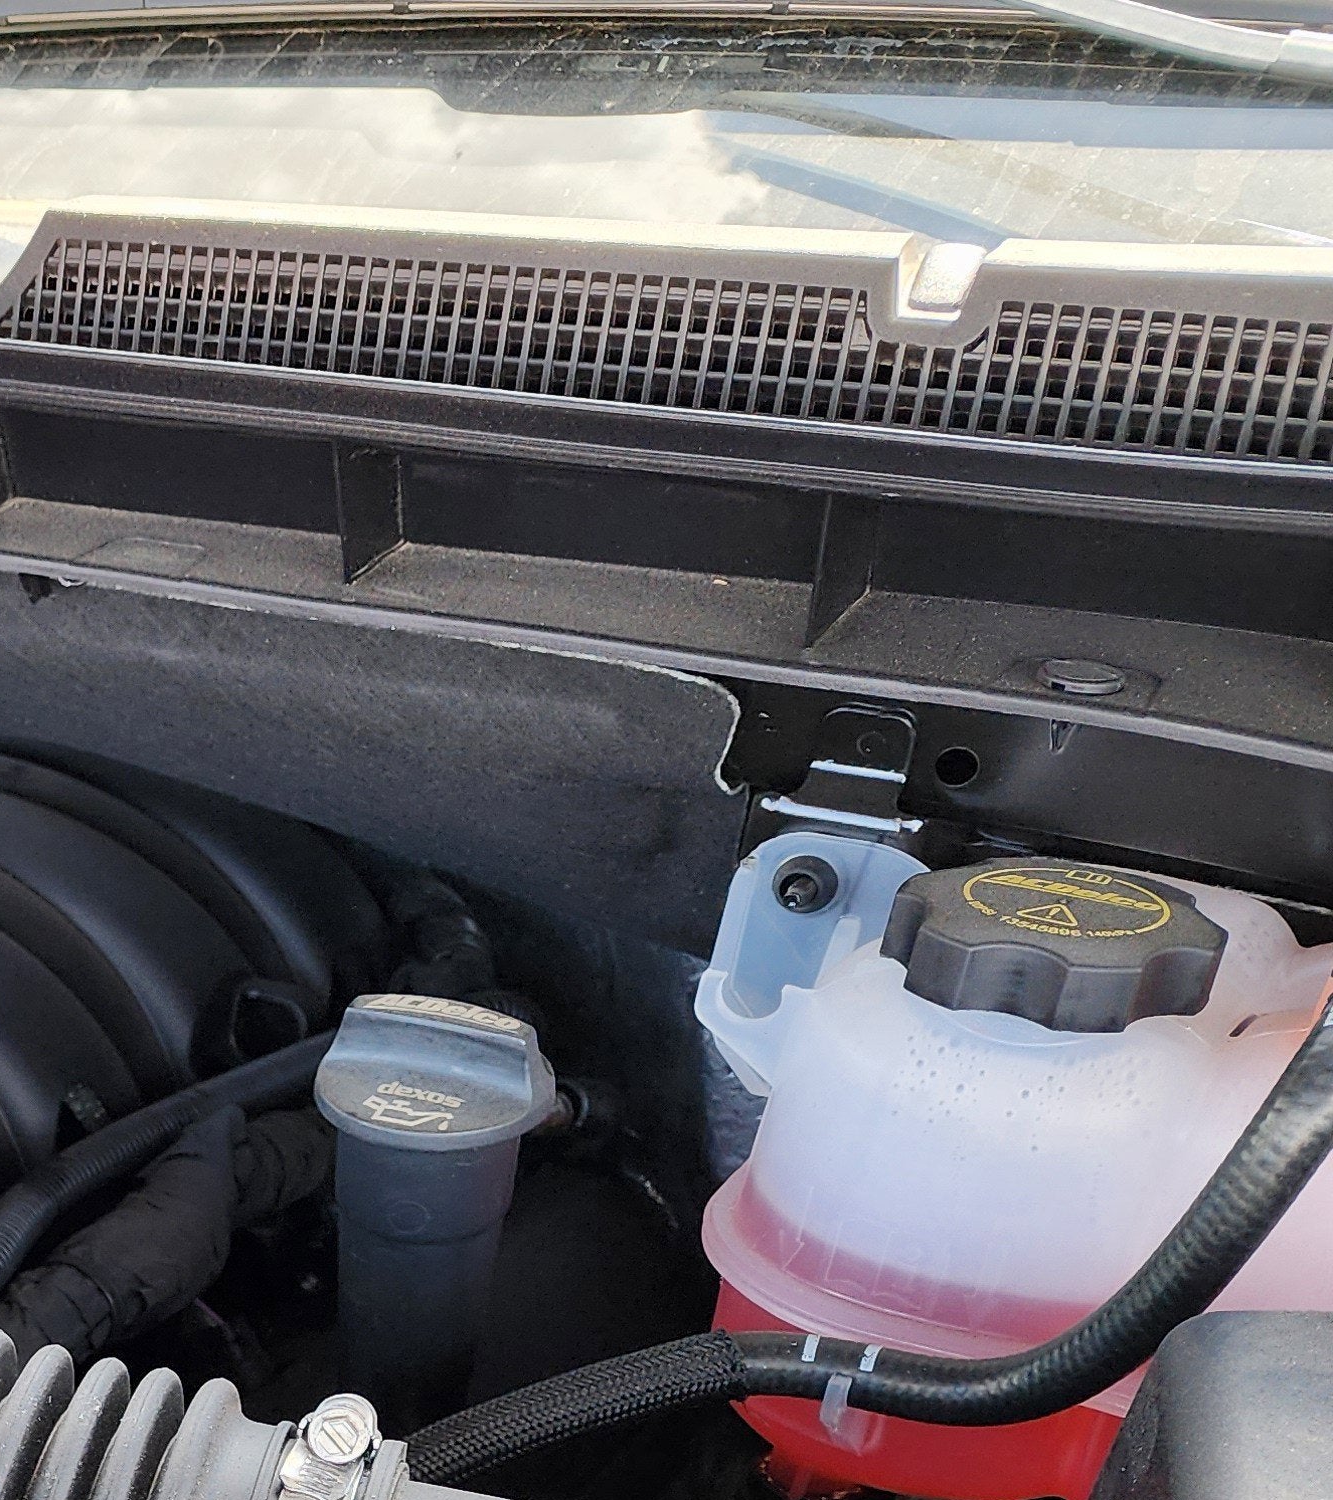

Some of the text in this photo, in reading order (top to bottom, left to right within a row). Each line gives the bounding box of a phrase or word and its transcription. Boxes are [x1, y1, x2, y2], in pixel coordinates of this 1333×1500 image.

[988, 875, 1162, 911] ACDelco
[365, 993, 521, 1030] ACDelco
[377, 1081, 467, 1108] dexos
